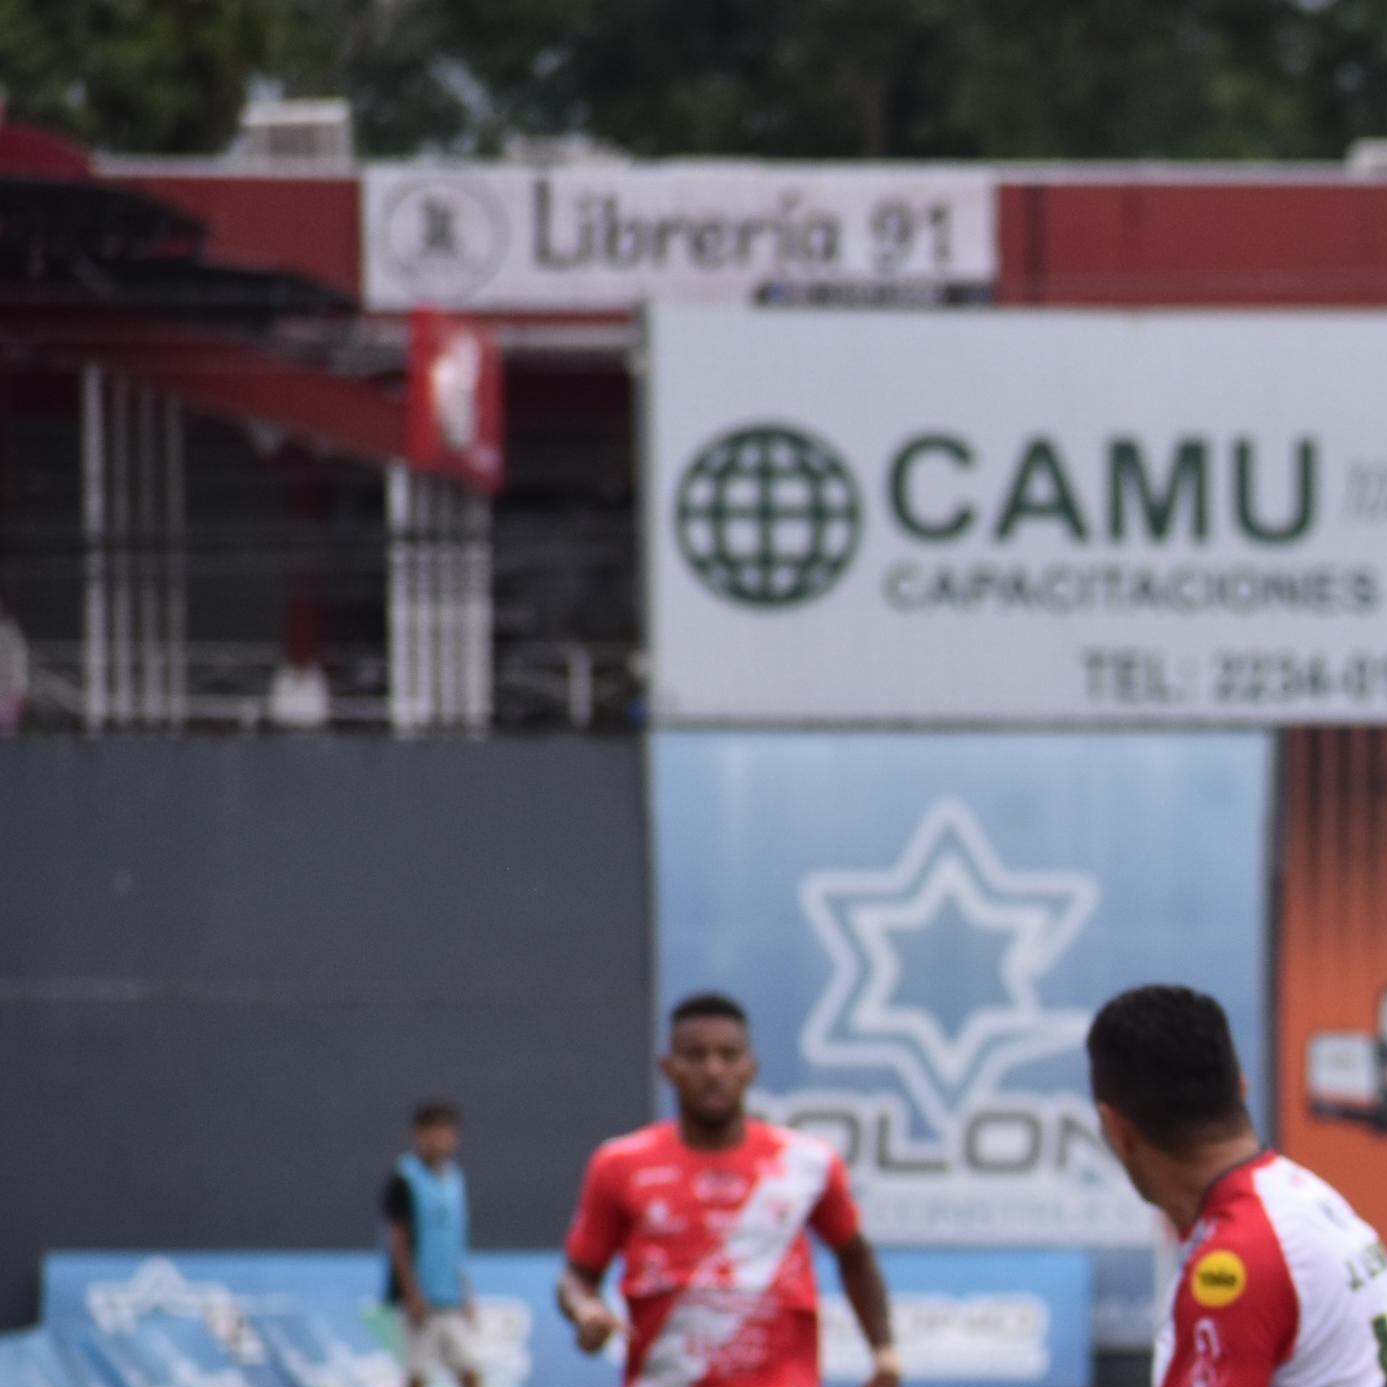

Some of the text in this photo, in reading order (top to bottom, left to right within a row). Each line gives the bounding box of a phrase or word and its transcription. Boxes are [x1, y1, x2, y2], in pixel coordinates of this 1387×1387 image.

[531, 177, 956, 272] Librería 91
[887, 431, 1318, 546] CAMU
[882, 562, 1380, 614] CAPACITACIONES
